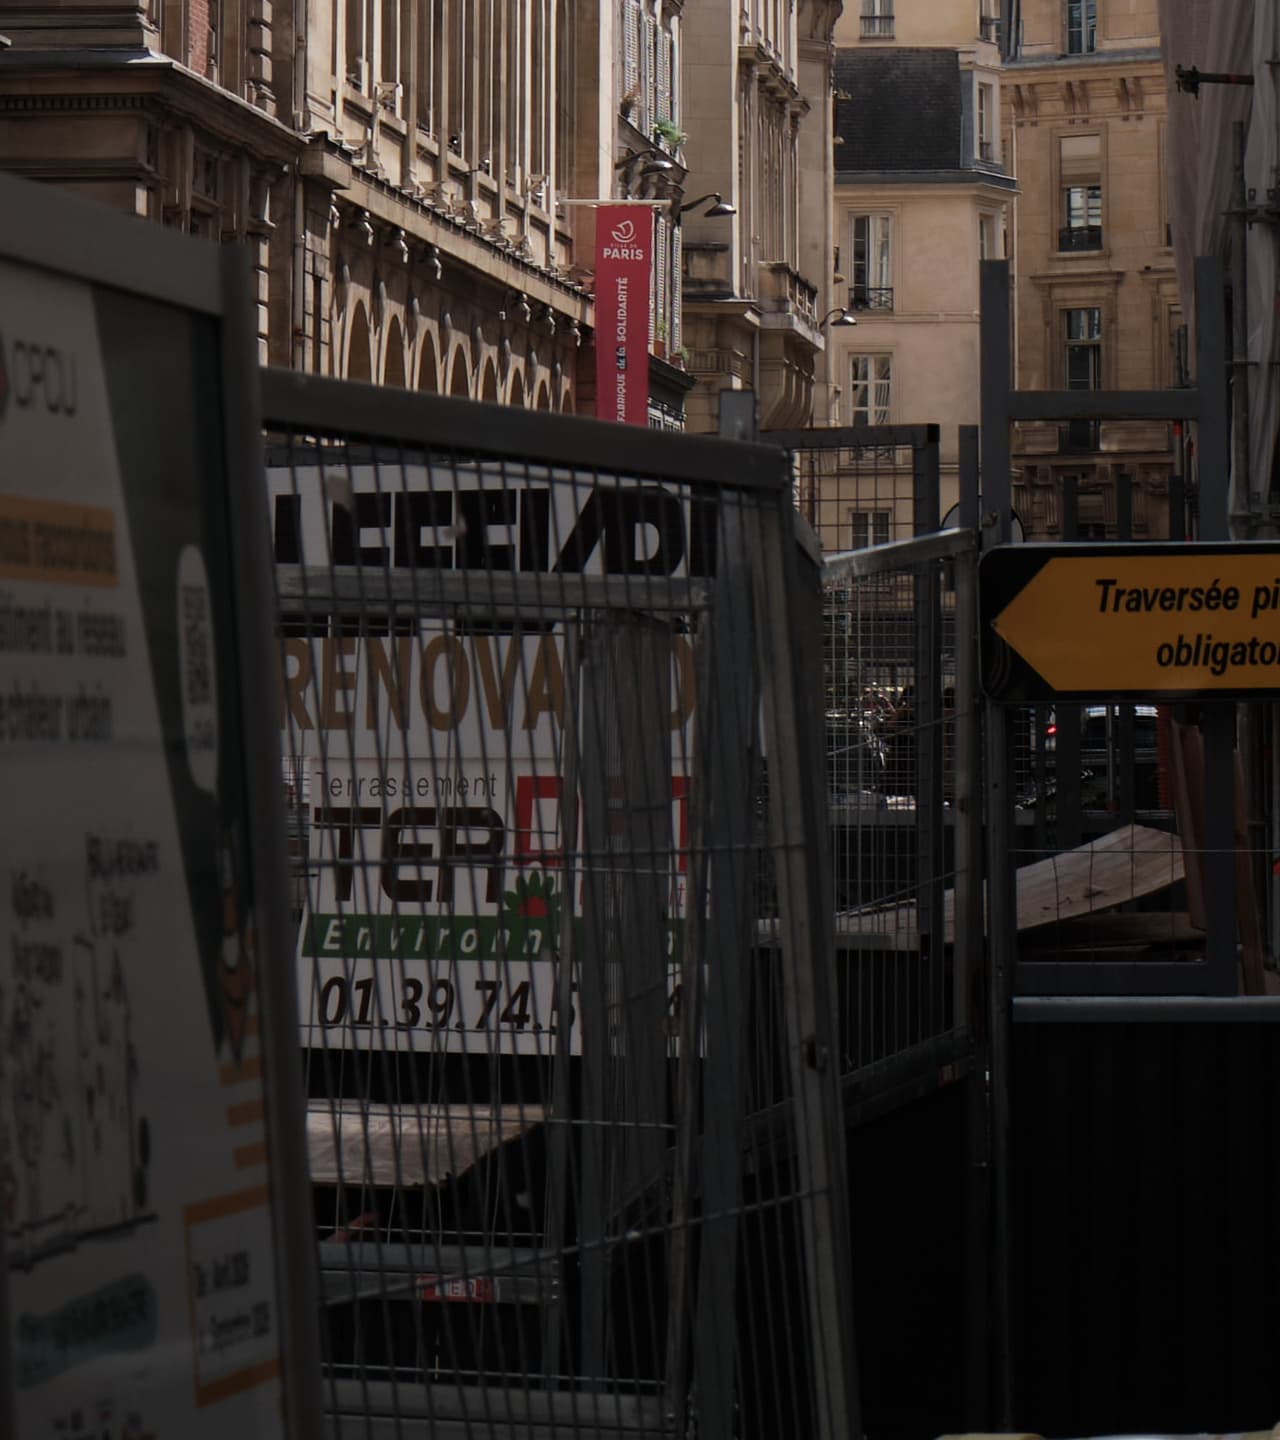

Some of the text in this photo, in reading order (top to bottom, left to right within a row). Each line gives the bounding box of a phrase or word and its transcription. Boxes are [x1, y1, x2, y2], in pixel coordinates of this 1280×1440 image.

[602, 247, 644, 261] PARIS
[616, 277, 629, 342] SOLIDARITÉ
[616, 372, 627, 423] FABRIQUE
[1096, 578, 1240, 612] Traversée
